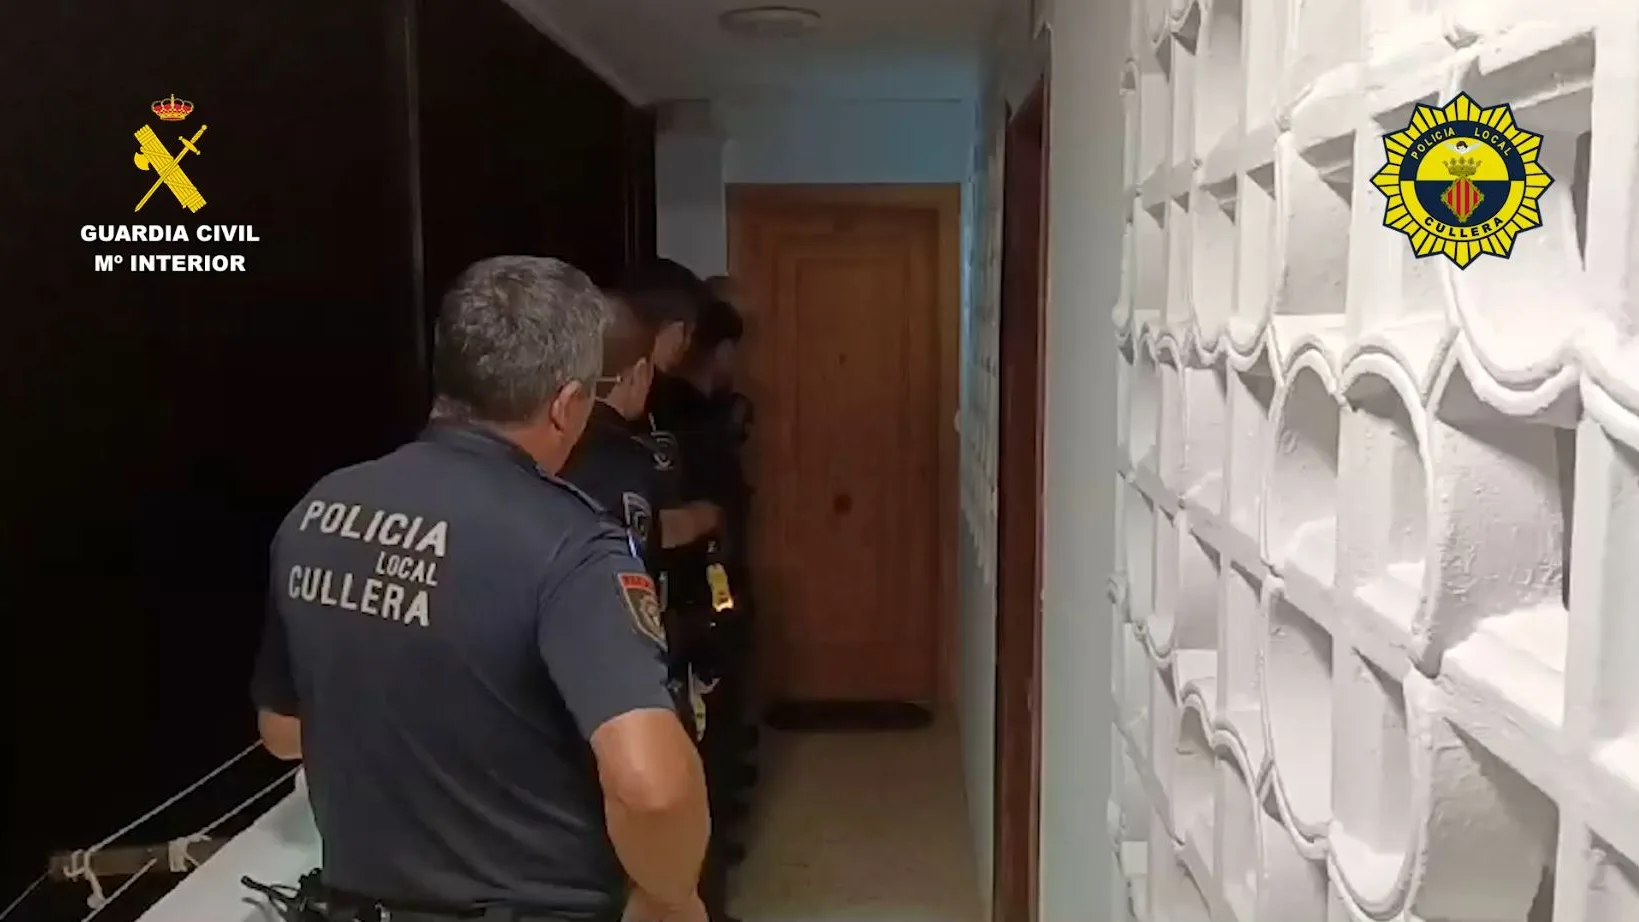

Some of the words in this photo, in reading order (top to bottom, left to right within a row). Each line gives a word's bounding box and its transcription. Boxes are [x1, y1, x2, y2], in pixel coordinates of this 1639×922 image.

[300, 500, 448, 557] POLICIA
[288, 565, 429, 627] CULLERA
[376, 551, 438, 586] LOCAL
